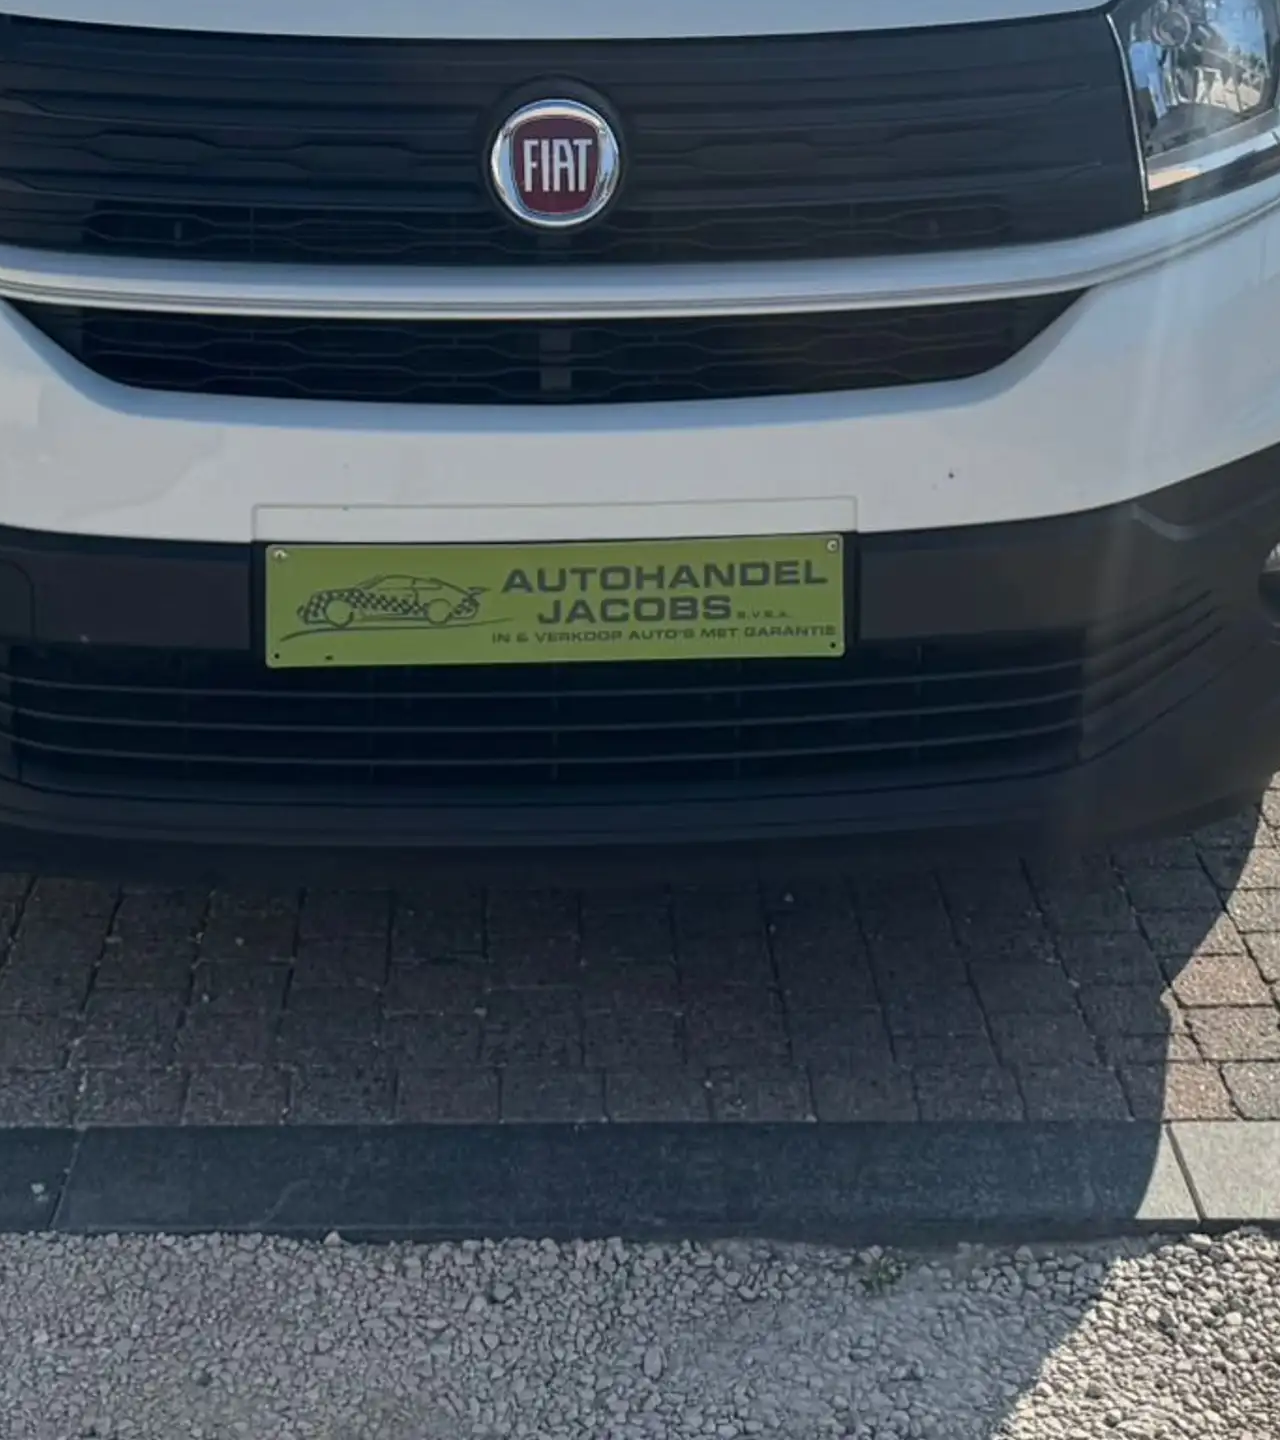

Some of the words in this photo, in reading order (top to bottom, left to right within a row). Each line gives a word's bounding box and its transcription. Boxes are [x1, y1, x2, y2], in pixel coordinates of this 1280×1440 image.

[522, 138, 593, 193] FIAT
[500, 560, 829, 593] AUTOHANDEL
[536, 594, 732, 625] JACOBS
[491, 632, 511, 644] IN
[533, 629, 623, 643] VERKOOP
[699, 627, 739, 639] MET
[743, 624, 837, 638] GARANTIE
